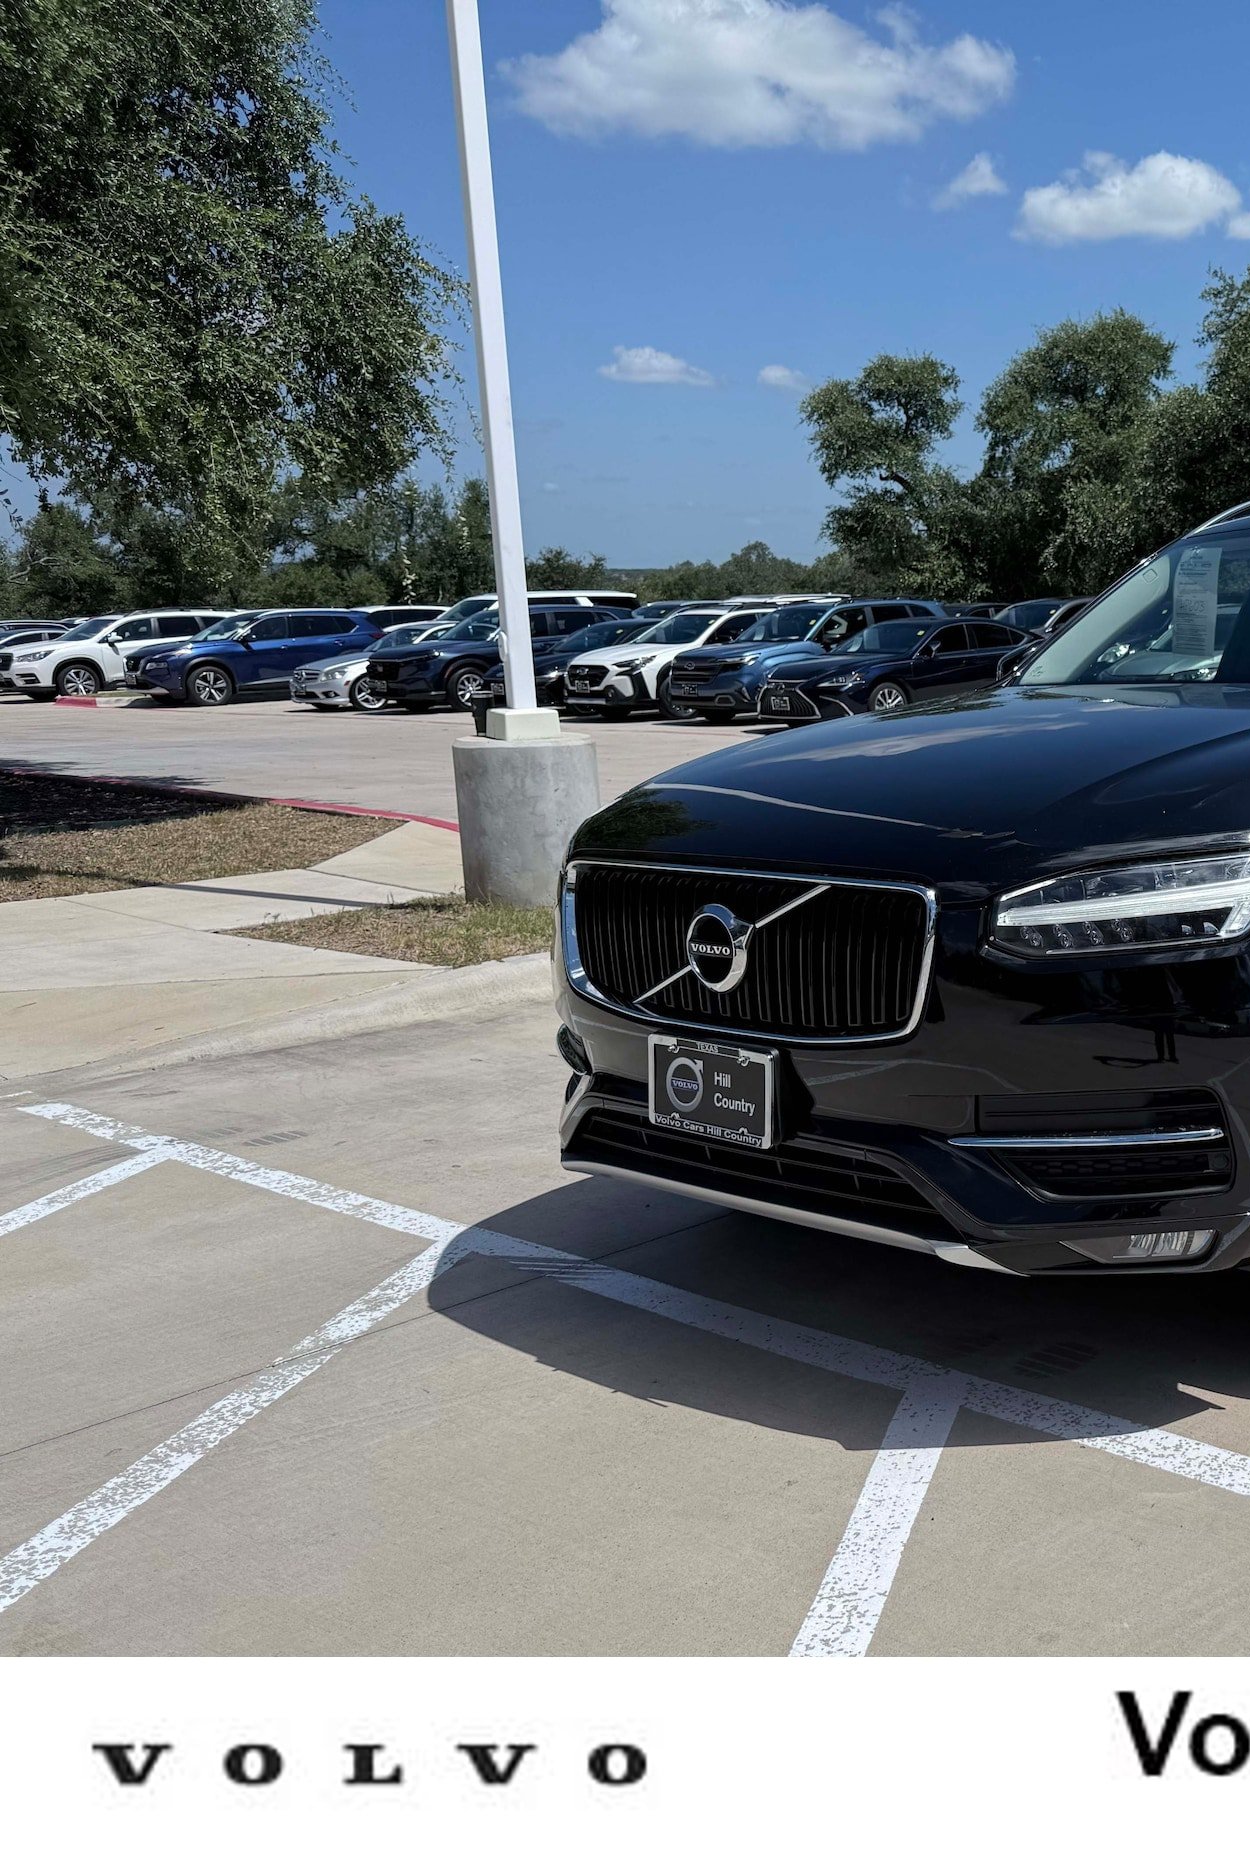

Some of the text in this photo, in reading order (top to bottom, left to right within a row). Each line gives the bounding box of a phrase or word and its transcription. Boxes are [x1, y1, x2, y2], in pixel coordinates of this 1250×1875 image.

[691, 943, 730, 956] VOLVO
[696, 1042, 719, 1053] TEXAS
[672, 1079, 698, 1091] VOLVO
[714, 1071, 731, 1088] Hill
[713, 1092, 755, 1116] Country
[655, 1115, 762, 1147] Volvo Cars Hill Country
